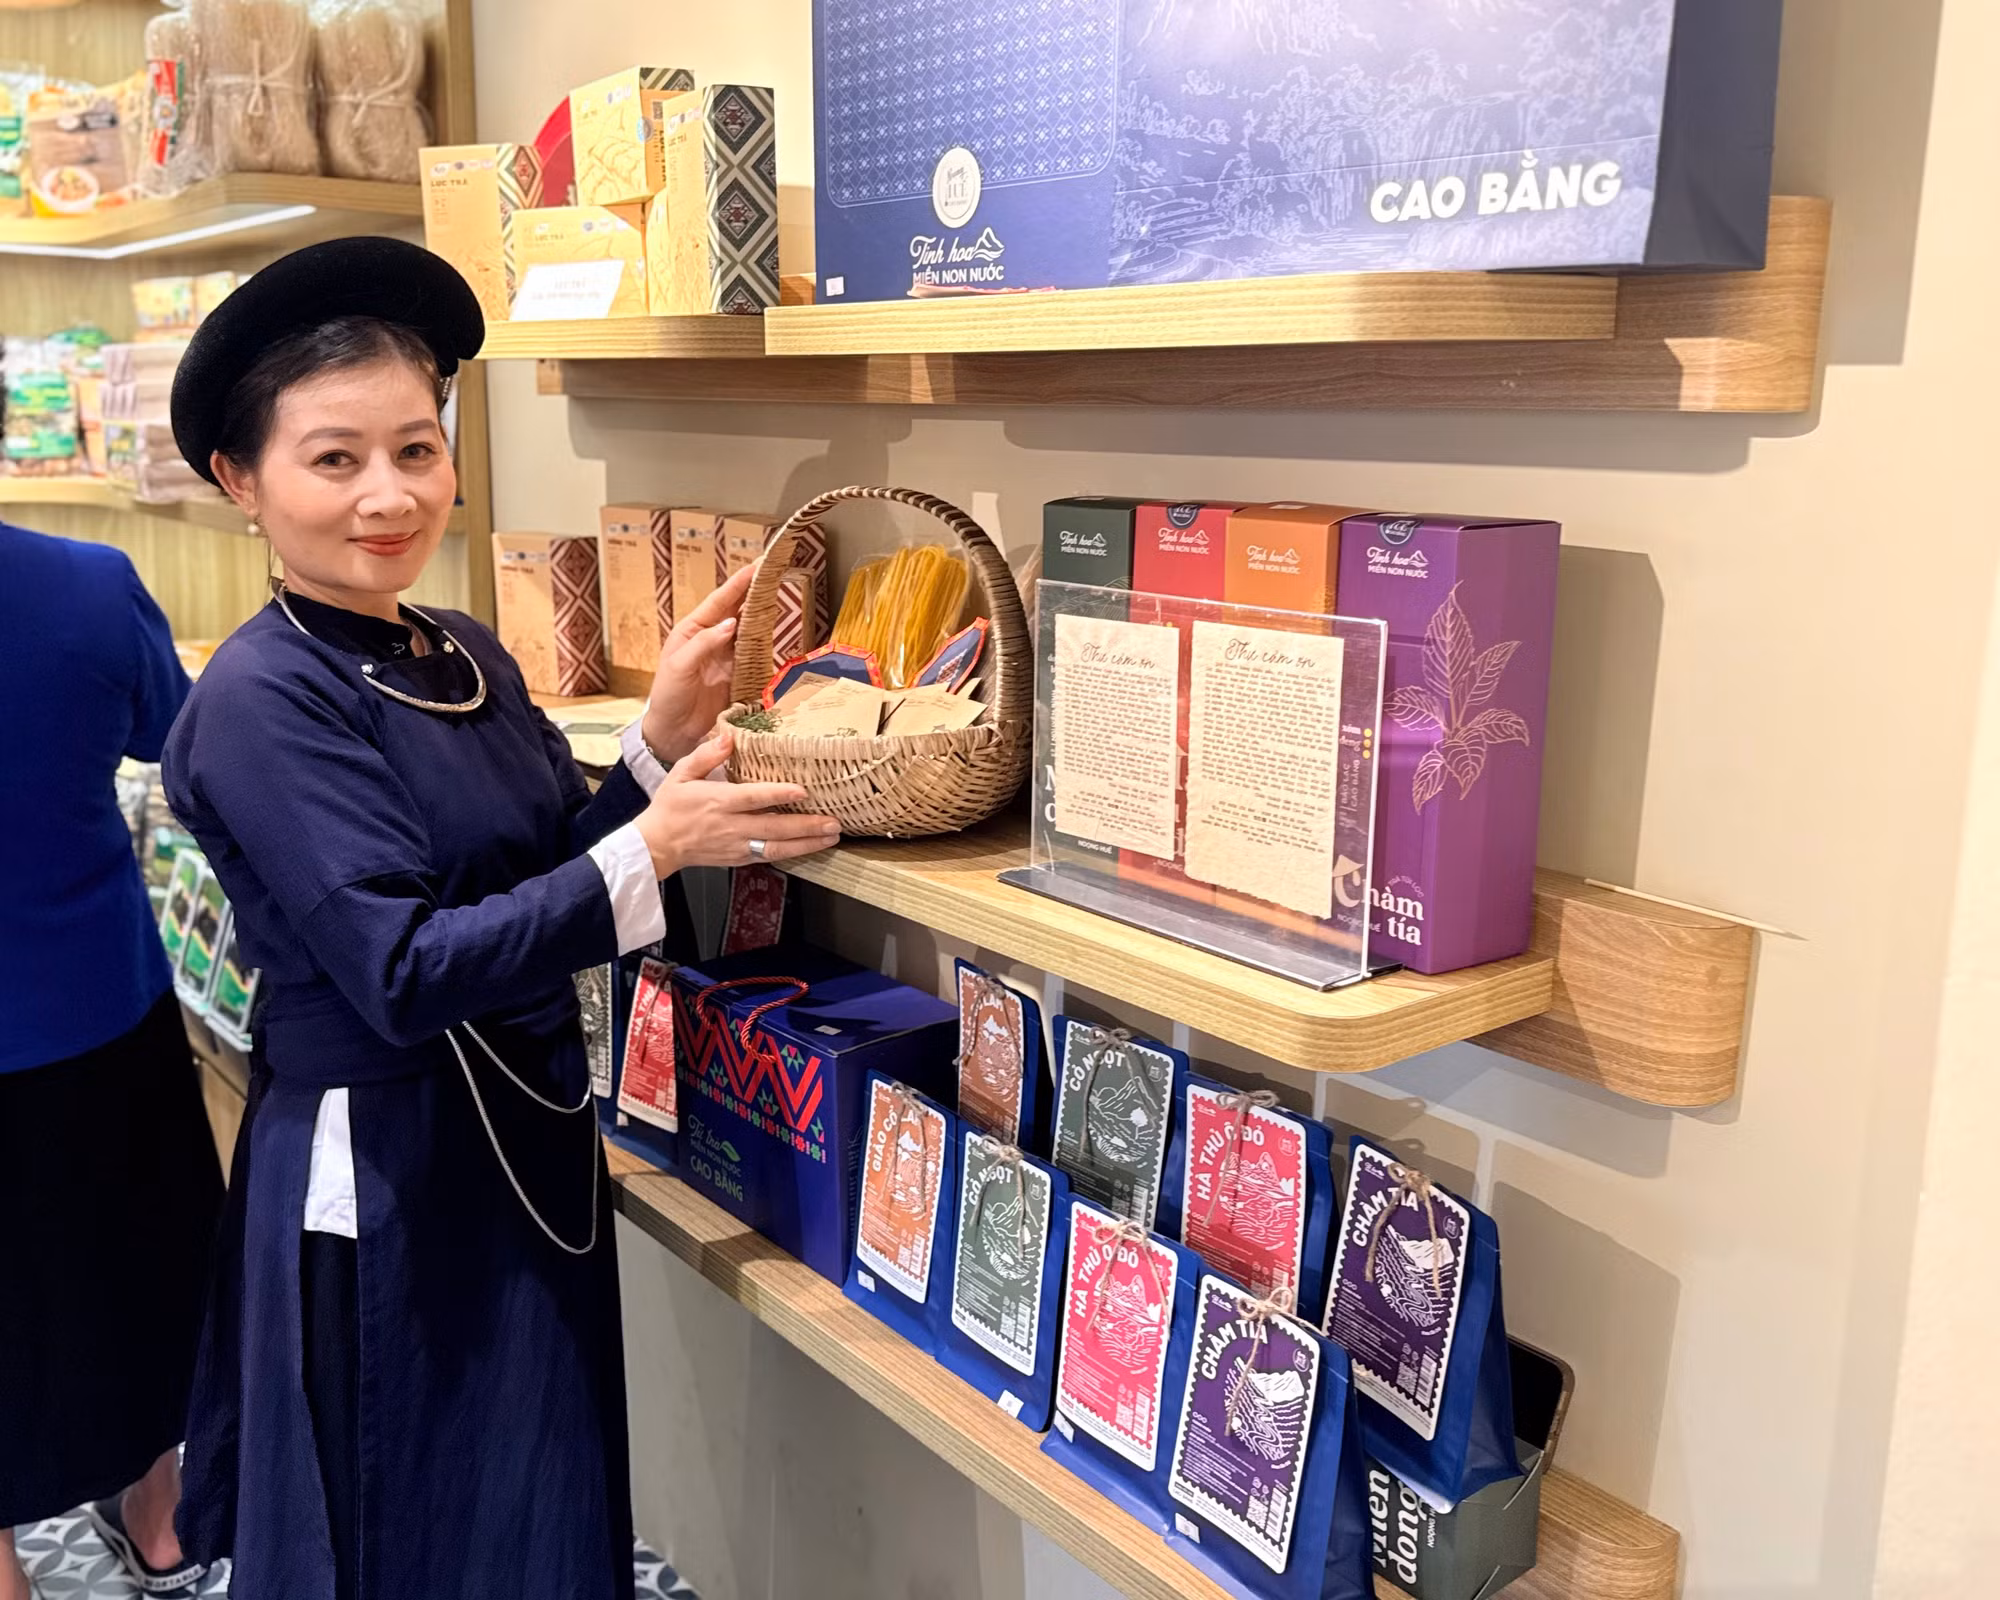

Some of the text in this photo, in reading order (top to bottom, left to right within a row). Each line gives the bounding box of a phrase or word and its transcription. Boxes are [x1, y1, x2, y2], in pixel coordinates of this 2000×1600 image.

[1370, 149, 1622, 223] CAO BẰNG
[947, 237, 975, 263] hoa
[942, 266, 966, 284] NON
[969, 262, 1004, 283] NƯỚC
[1387, 915, 1422, 946] tía
[1070, 1064, 1086, 1092] CỎ
[1199, 1127, 1226, 1168] THỦ
[690, 1155, 712, 1180] CAO
[968, 1178, 982, 1206] CỎ
[1195, 1172, 1212, 1201] HÀ
[1352, 1190, 1389, 1248] CHÀM
[1078, 1245, 1102, 1284] THỦ
[1201, 1322, 1238, 1380] CHÀM
